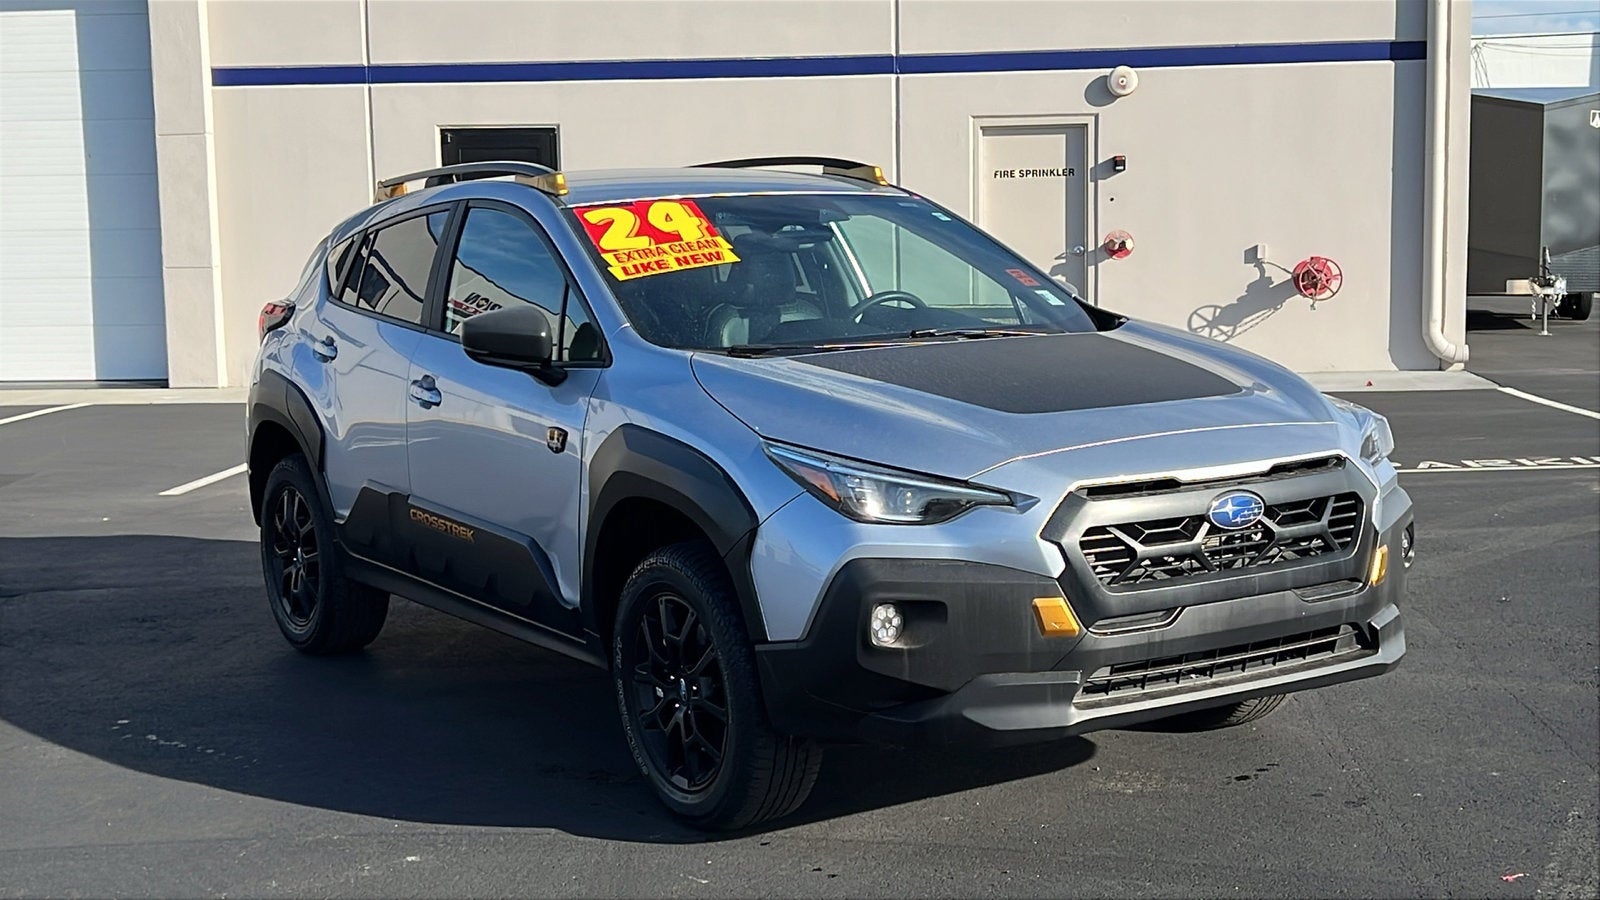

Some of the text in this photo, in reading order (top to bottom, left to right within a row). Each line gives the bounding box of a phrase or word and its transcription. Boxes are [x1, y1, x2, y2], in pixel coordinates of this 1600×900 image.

[993, 168, 1076, 178] FIRE SPRINKLER
[583, 201, 706, 250] 24
[613, 237, 720, 264] EXTRA CLEAN
[621, 250, 724, 277] LIKE NEW
[409, 508, 475, 543] CROSSTREK
